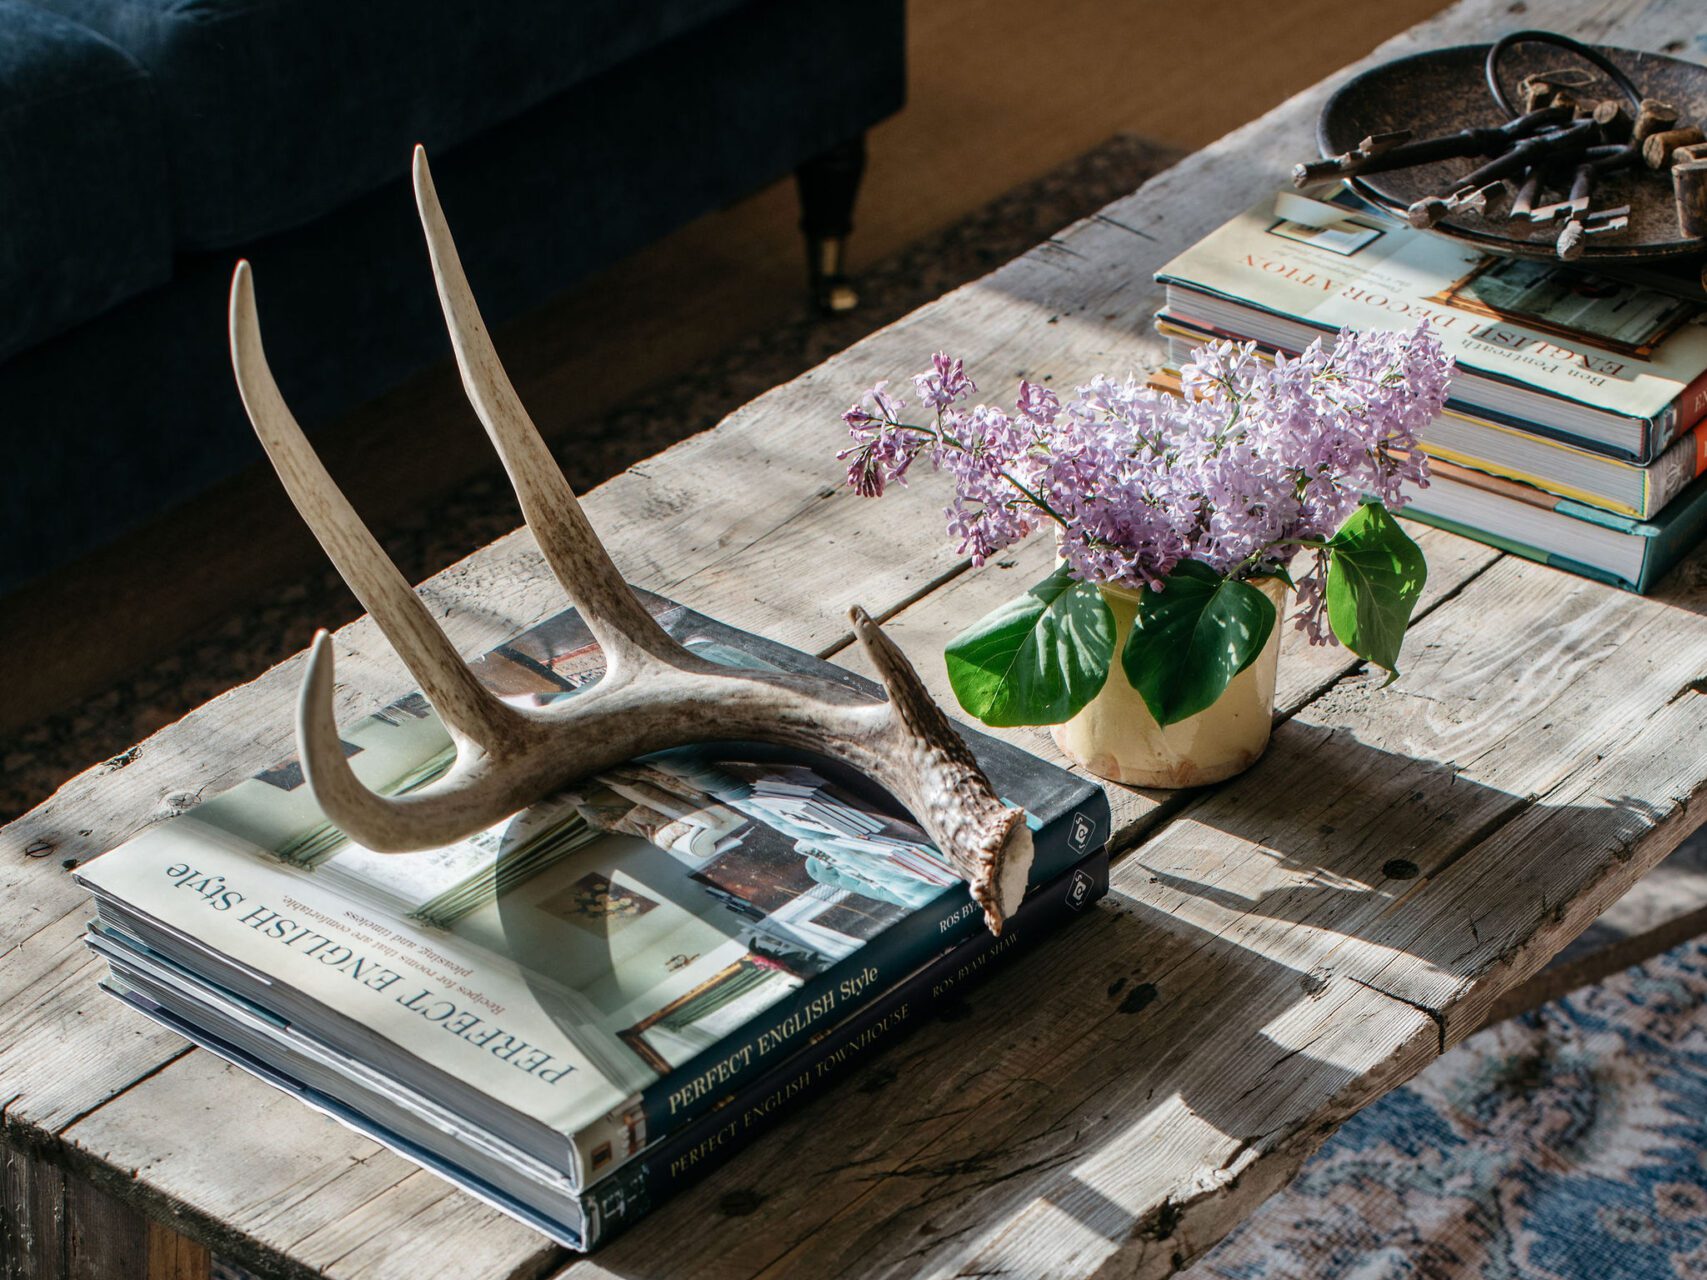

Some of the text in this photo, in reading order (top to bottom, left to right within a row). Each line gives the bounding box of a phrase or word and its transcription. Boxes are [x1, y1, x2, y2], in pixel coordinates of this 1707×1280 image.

[1237, 254, 1457, 328] DECORATION
[1461, 338, 1606, 387] Ben Pentreath
[1466, 323, 1627, 376] ENGLISH
[344, 910, 393, 936] timeless
[939, 911, 960, 933] ROS
[351, 931, 373, 944] are
[372, 941, 398, 957] that
[391, 933, 417, 949] and
[166, 863, 578, 1085] PERFECT ENGLISH Style
[400, 955, 438, 977] rooms
[932, 932, 1018, 998] ROS BYAM SHAW
[437, 975, 456, 989] for
[456, 985, 506, 1015] Recipes
[668, 967, 879, 1115] PERFECT ENGLISH Style
[670, 1002, 910, 1178] PERFECT ENGLISH TOWNHOUSE
